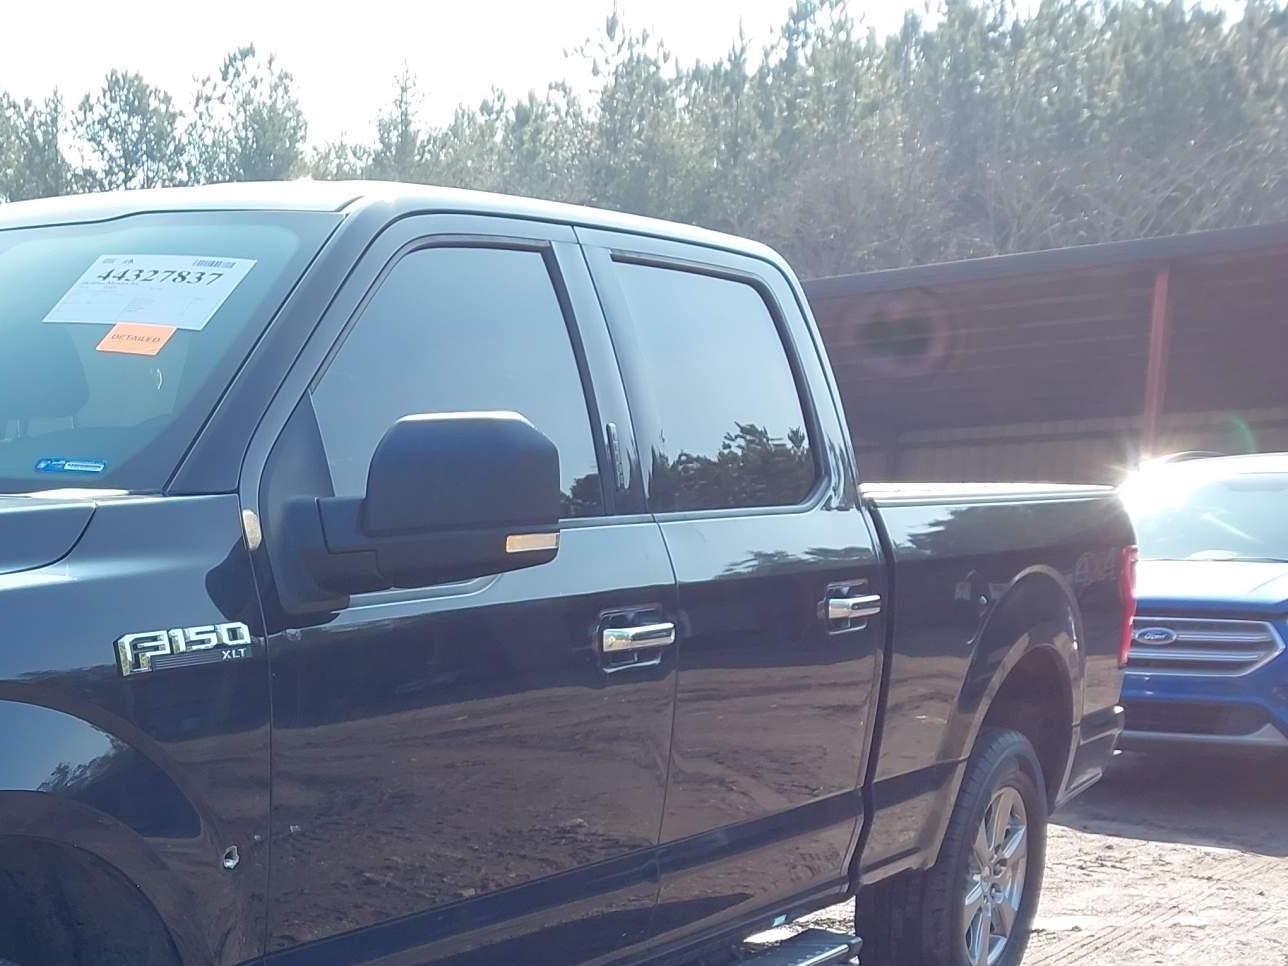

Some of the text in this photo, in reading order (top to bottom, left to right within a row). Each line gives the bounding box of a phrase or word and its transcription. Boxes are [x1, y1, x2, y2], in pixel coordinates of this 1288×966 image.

[97, 268, 224, 286] 44327837
[112, 332, 161, 343] DETAILED
[221, 647, 248, 660] XLT
